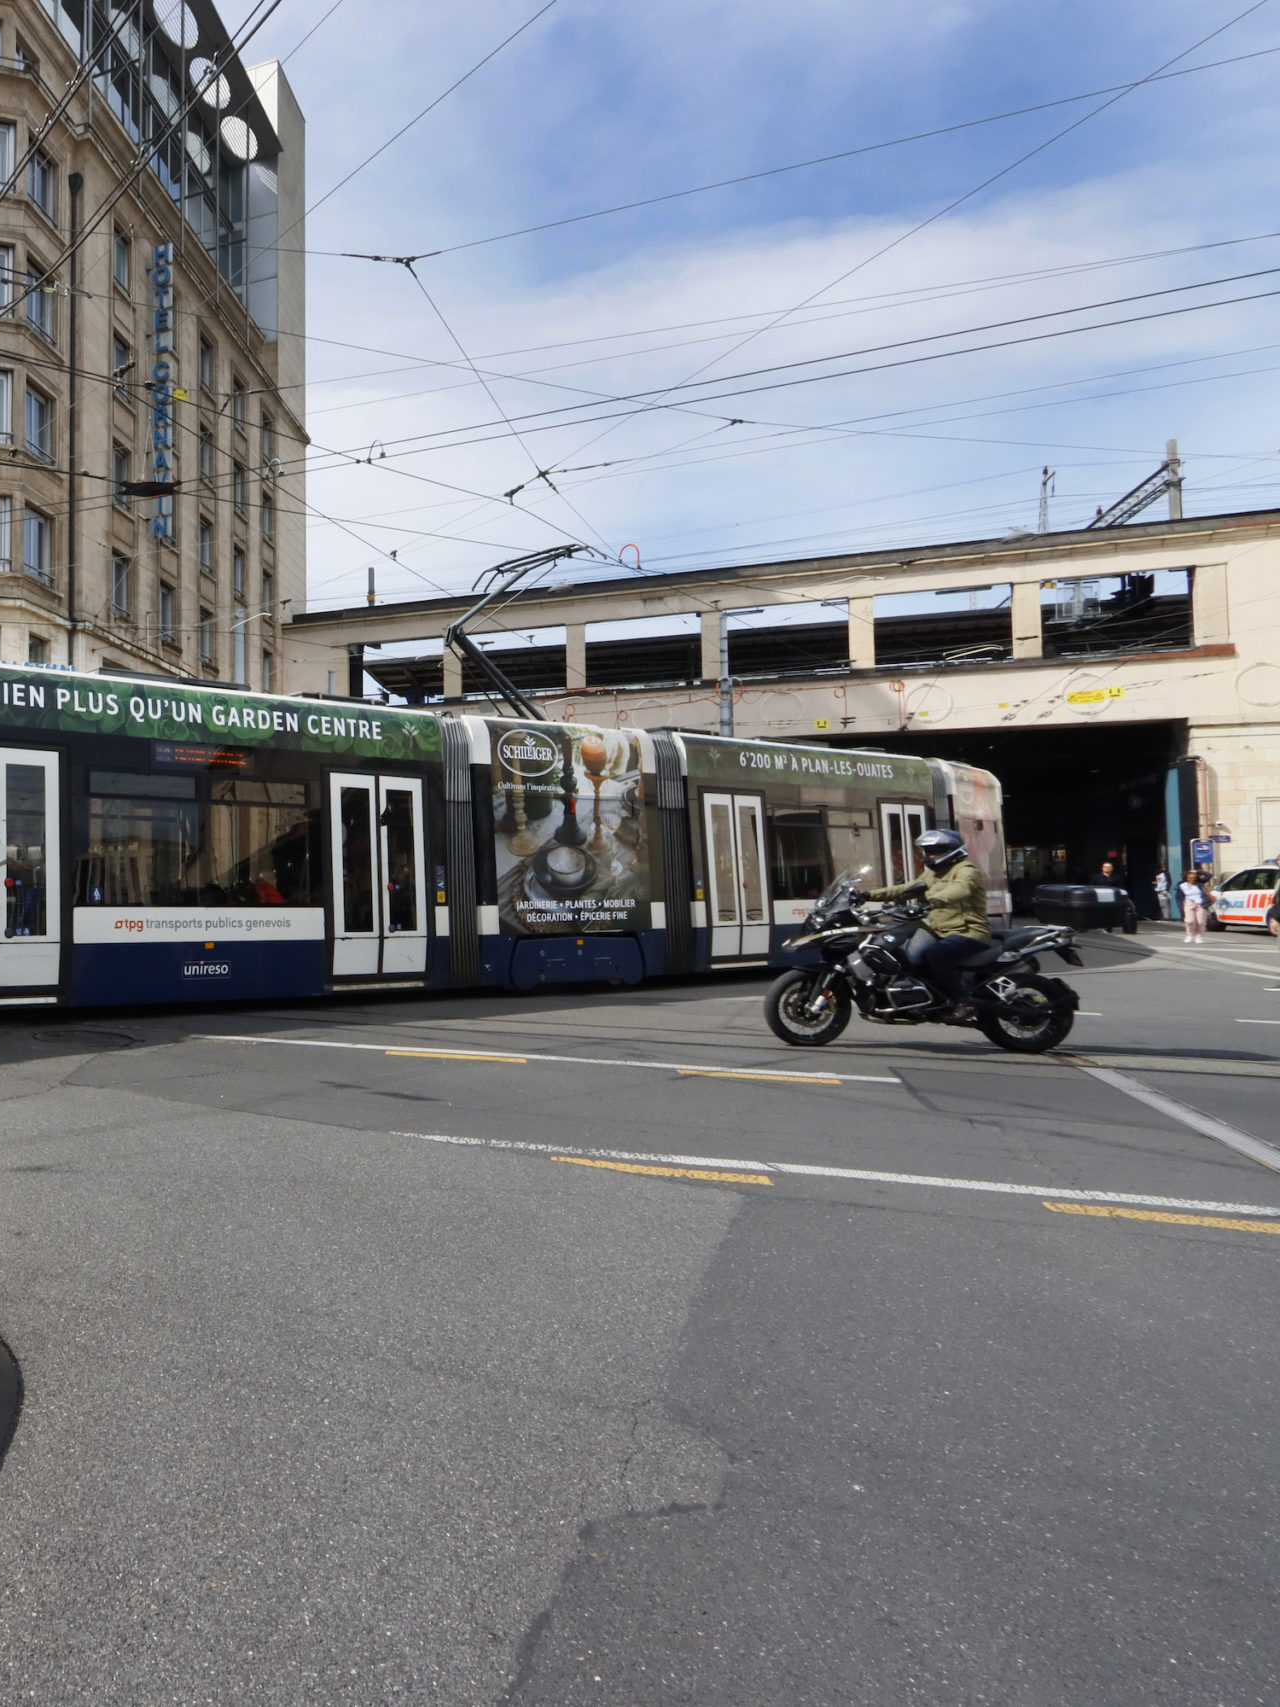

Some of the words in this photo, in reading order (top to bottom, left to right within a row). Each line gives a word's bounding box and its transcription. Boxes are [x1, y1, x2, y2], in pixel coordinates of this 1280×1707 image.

[153, 243, 170, 352] HOTEL
[56, 688, 119, 716] PLUS
[129, 697, 203, 724] QU'UN
[212, 705, 299, 733] GARDEN
[307, 714, 383, 740] CENTRE
[503, 744, 553, 761] SCHILLIGER
[740, 752, 771, 769] 6'200
[790, 753, 799, 771] À
[801, 757, 894, 778] PLAN-LES-OUATES
[526, 782, 562, 793] l'inspirati
[516, 900, 558, 911] JARDINERIE
[565, 899, 596, 909] PLANTES
[603, 898, 636, 909] MOBILIER
[526, 911, 573, 923] DÉCORATION
[580, 910, 611, 921] ÉPICERIE
[612, 910, 628, 920] FINE
[124, 919, 144, 933] tpg
[146, 918, 203, 932] transports
[205, 917, 244, 931] publics
[245, 917, 291, 931] genevois
[183, 960, 229, 976] unireso
